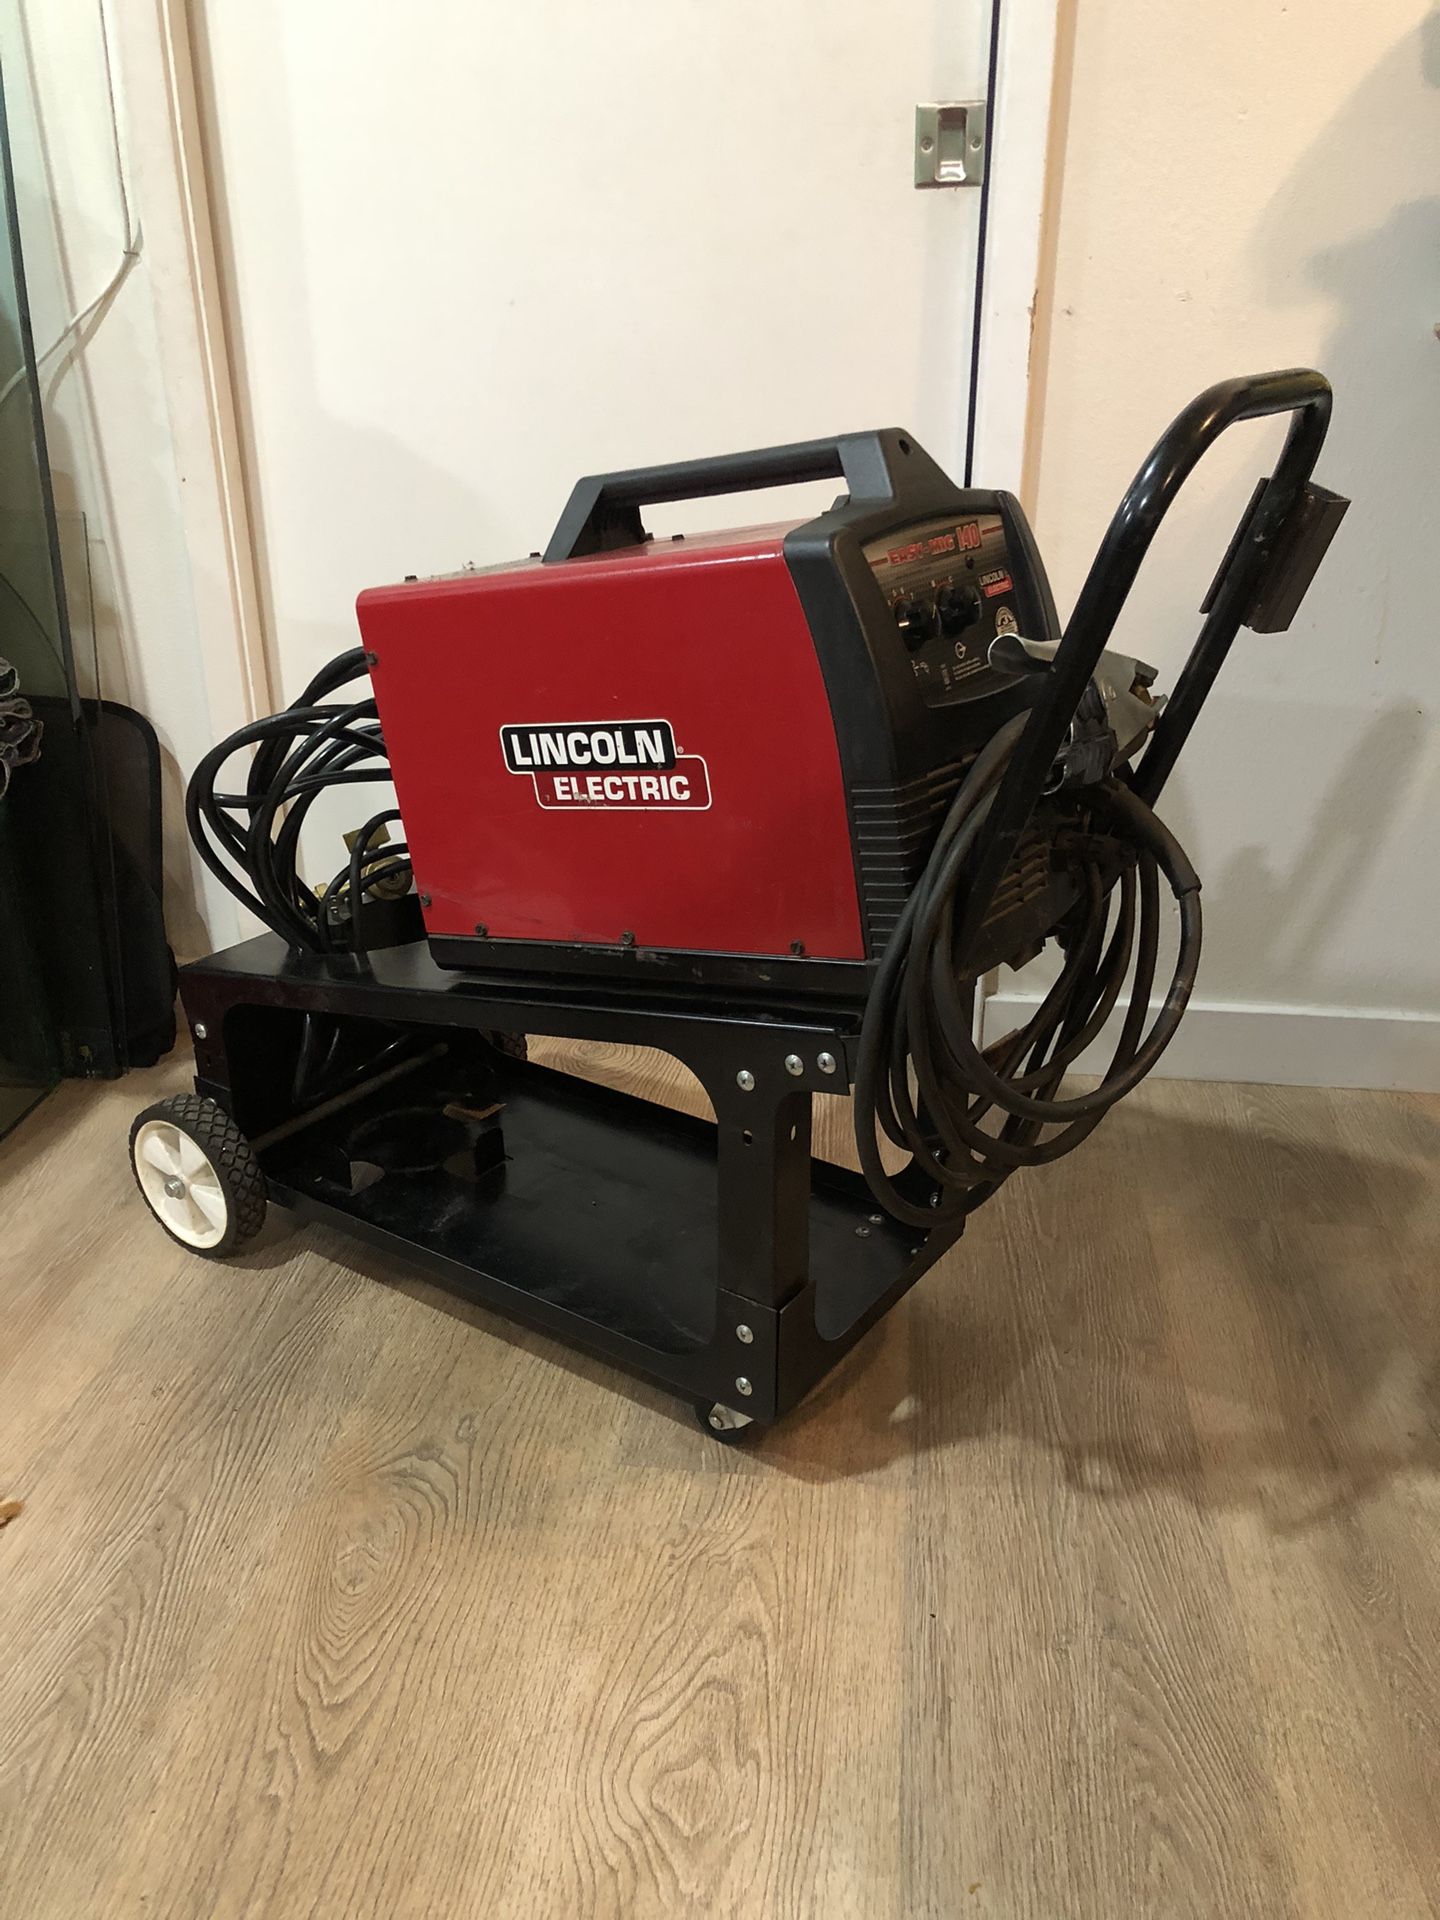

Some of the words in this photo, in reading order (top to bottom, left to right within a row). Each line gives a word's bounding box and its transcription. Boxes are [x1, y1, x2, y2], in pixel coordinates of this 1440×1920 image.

[956, 523, 981, 550] 140
[510, 729, 666, 766] LINCOLN
[553, 775, 691, 801] ELECTRIC
